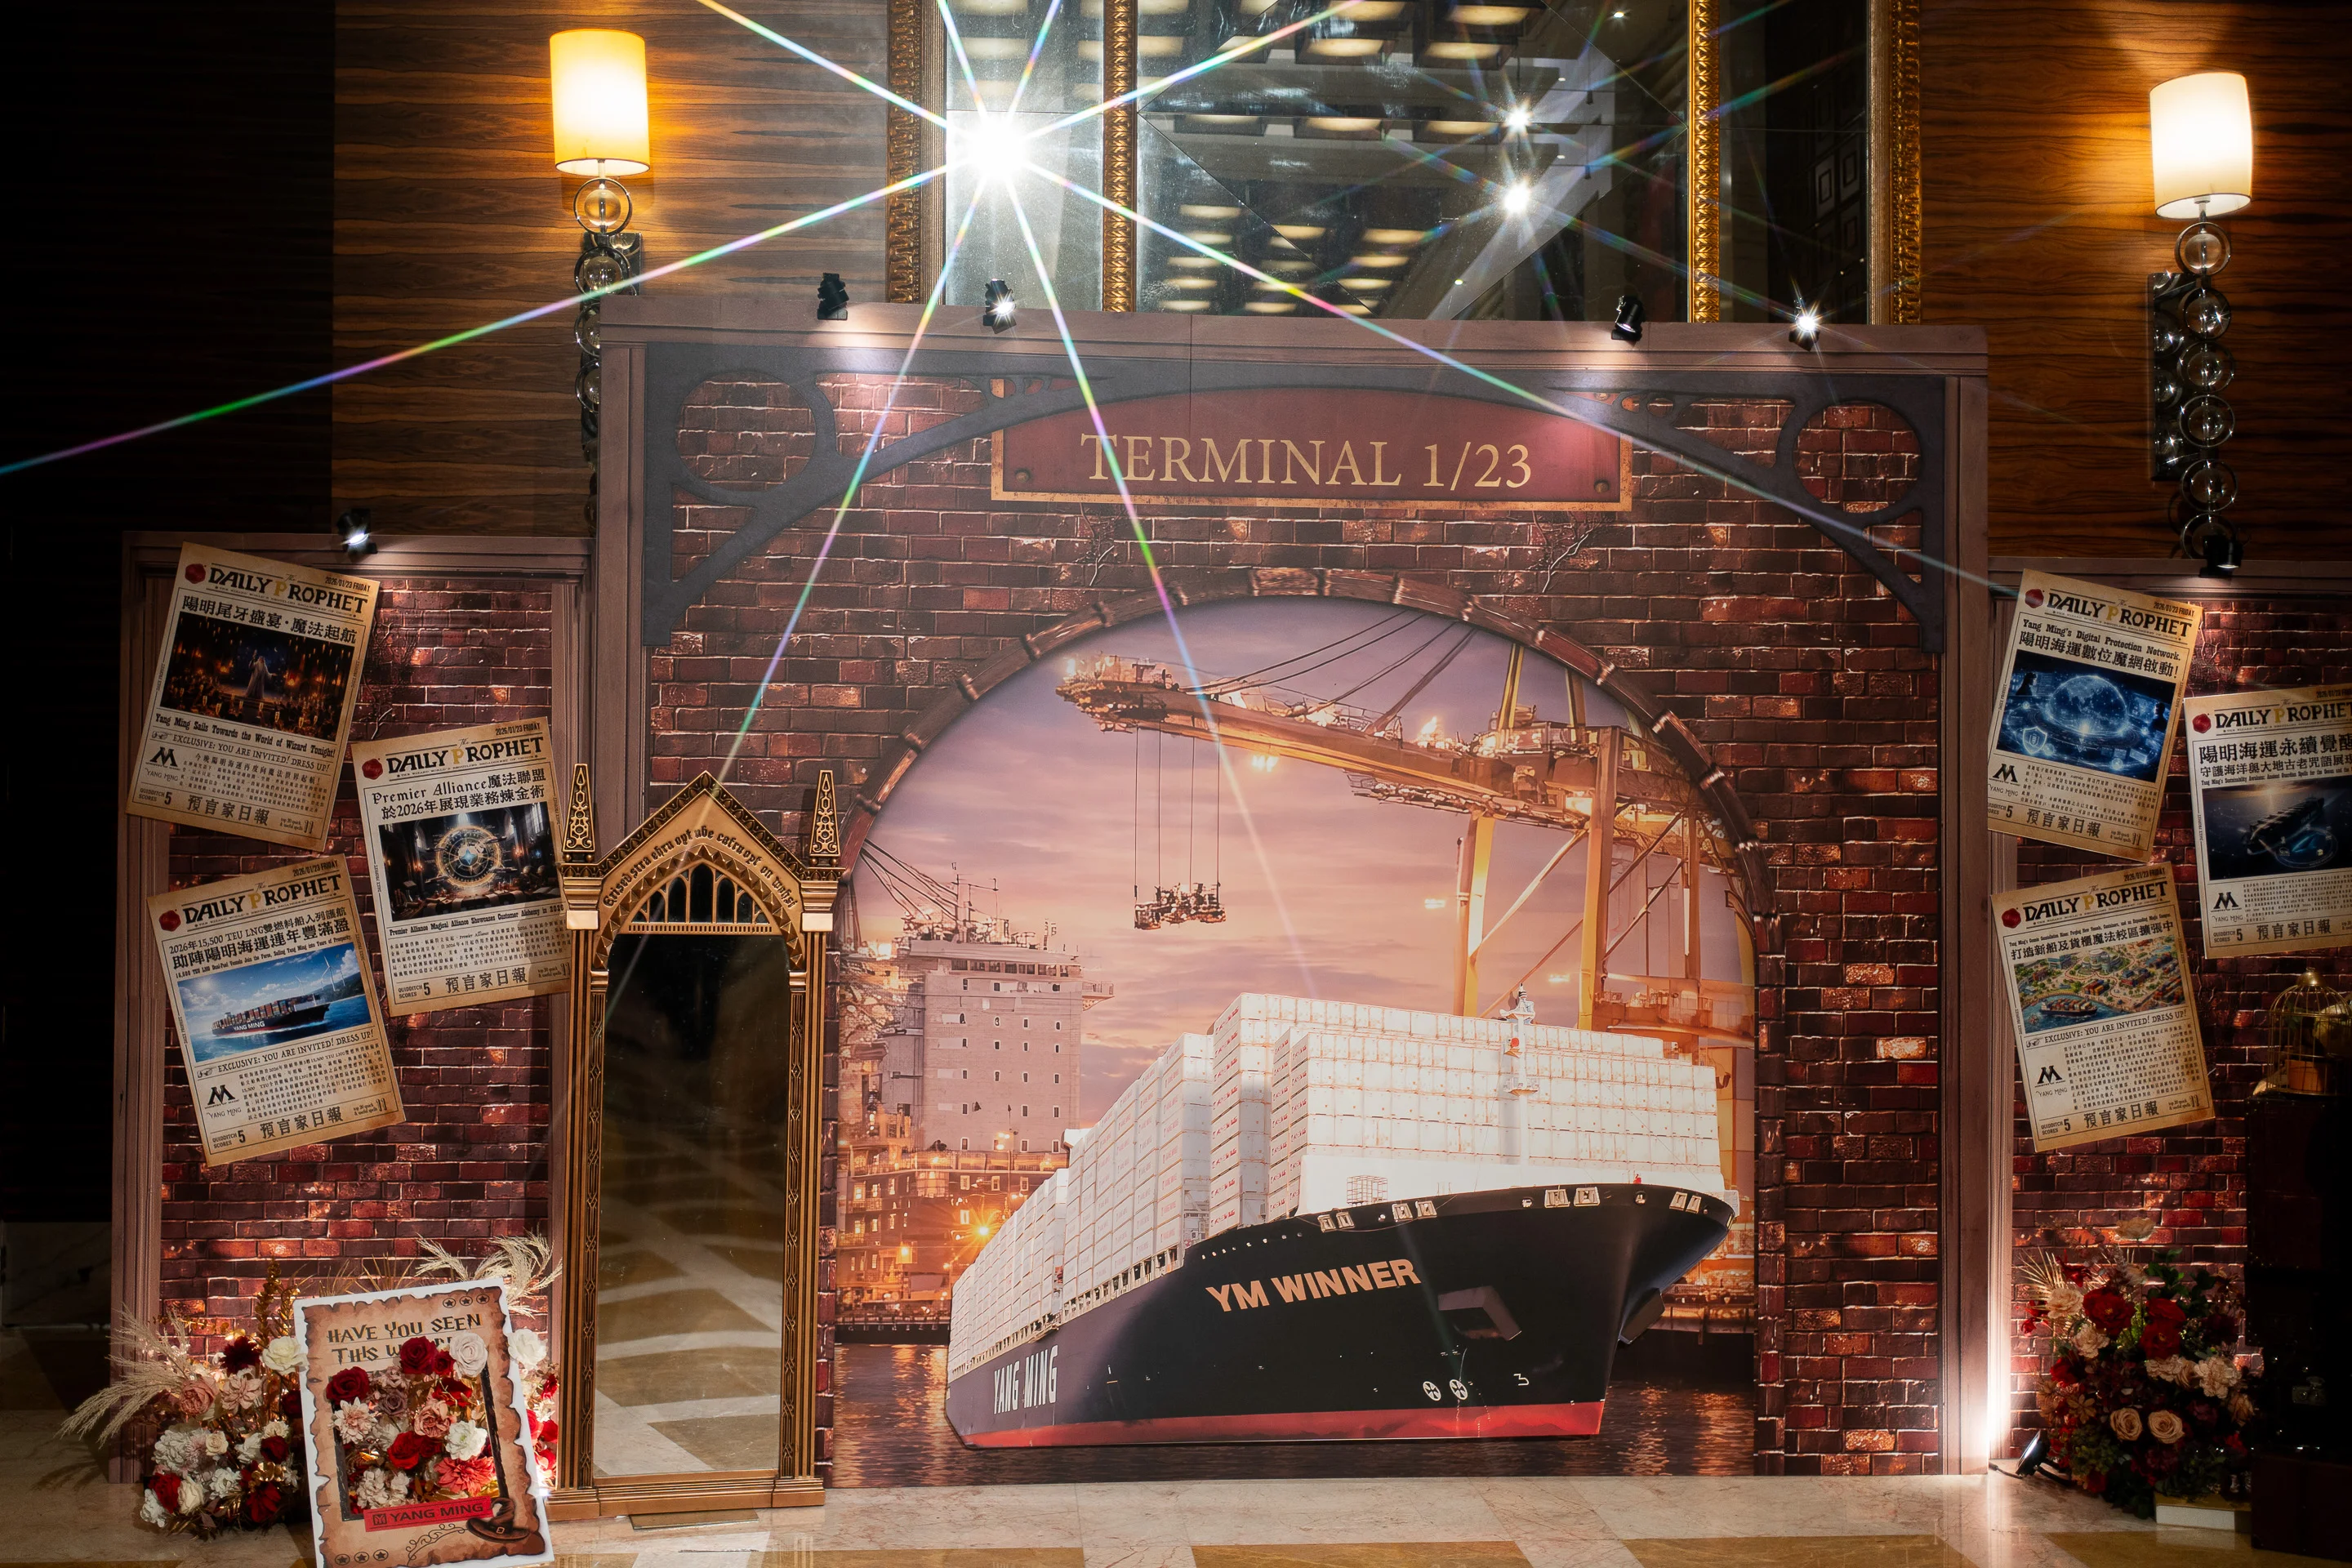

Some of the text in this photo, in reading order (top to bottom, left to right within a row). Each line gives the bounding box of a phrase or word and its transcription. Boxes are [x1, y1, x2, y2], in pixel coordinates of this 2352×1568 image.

[1080, 433, 1532, 491] TERMINAL 1/23
[207, 567, 274, 594] DAILY
[273, 580, 368, 613] PROPHET
[324, 576, 370, 592] 2026/01/23 FRIDAY
[2047, 592, 2106, 618] DAILY
[2105, 605, 2192, 637] PROPHET
[2153, 601, 2194, 617] 2026/01/23 FRIDAY
[2023, 618, 2042, 632] Yang
[2045, 623, 2072, 637] Ming's
[2075, 630, 2101, 644] Digital
[2104, 636, 2142, 653] Protection
[2145, 645, 2180, 661] Network.
[2214, 708, 2272, 728] DAILY
[155, 712, 336, 759] Yang Ming Sails Towards the World of Wizard Tonight!
[495, 722, 540, 736] 2026/01/23 FRIDAY
[172, 733, 330, 772] EXCLUSIVE: YOU ARE INVITED! DRESS UP!
[385, 750, 448, 774] DAILY
[451, 736, 544, 764] PROPHET
[144, 767, 178, 782] YANG MING
[138, 793, 157, 802] SCORES
[163, 791, 172, 805] 5
[371, 787, 426, 804] Premier
[1986, 783, 2018, 797] YANG MING
[185, 794, 270, 826] 預言家日報
[2005, 804, 2013, 818] 5
[2025, 808, 2101, 839] 預言家日報
[292, 860, 338, 877] 2026/01/23 FRIDAY
[603, 872, 632, 906] Erised
[630, 857, 652, 879] stra
[652, 841, 675, 860] ehru
[760, 866, 773, 879] on
[2123, 867, 2165, 882] 2026/01/23 FRIDAY
[181, 894, 246, 924] DAILY
[247, 873, 341, 910] PROPHET
[2022, 896, 2080, 922] DAILY
[2082, 880, 2168, 911] PROPHET
[389, 927, 408, 936] Premier
[410, 925, 429, 933] Alliance
[430, 920, 449, 931] Magical
[451, 919, 469, 927] Alliance
[470, 915, 496, 924] Showcases
[497, 912, 519, 920] Customer
[521, 908, 540, 916] Alchemy
[549, 904, 564, 912] 2026
[2230, 915, 2243, 923] MING
[225, 930, 243, 942] TEU
[2236, 928, 2243, 942] 5
[2256, 918, 2332, 941] 預言家日報
[172, 916, 350, 970] 助陣陽明海運連年豐滿盈
[2011, 920, 2174, 960] 打造新船及貨櫃魔法校區擴張中
[398, 984, 423, 993] QUIDDITCH
[422, 982, 431, 996] 5
[445, 966, 528, 994] 預言家日報
[399, 991, 417, 999] SCORES
[247, 1021, 265, 1029] MING
[2044, 1008, 2186, 1044] EXCLUSIVE: YOU ARE INVITED! DRESS UP!
[217, 1028, 373, 1072] EXCLUSIVE: YOU ARE INVITED! DRESS UP!
[2054, 1087, 2068, 1096] MING
[206, 1107, 242, 1119] YANG MING
[2083, 1100, 2159, 1129] 預言家日報
[259, 1106, 344, 1140] 預言家日報
[2040, 1120, 2064, 1129] QUIDDITCH
[2041, 1127, 2059, 1135] SCORES
[2063, 1118, 2071, 1132] 5
[212, 1132, 238, 1143] QUIDDITCH
[213, 1139, 233, 1149] SCORES
[237, 1129, 246, 1143] 5
[1205, 1258, 1422, 1312] YM WINNER
[327, 1313, 482, 1343] HAVE YOU SEEN
[332, 1345, 379, 1365] THIS
[994, 1344, 1058, 1414] YANG MING
[390, 1503, 483, 1522] YANG MING
